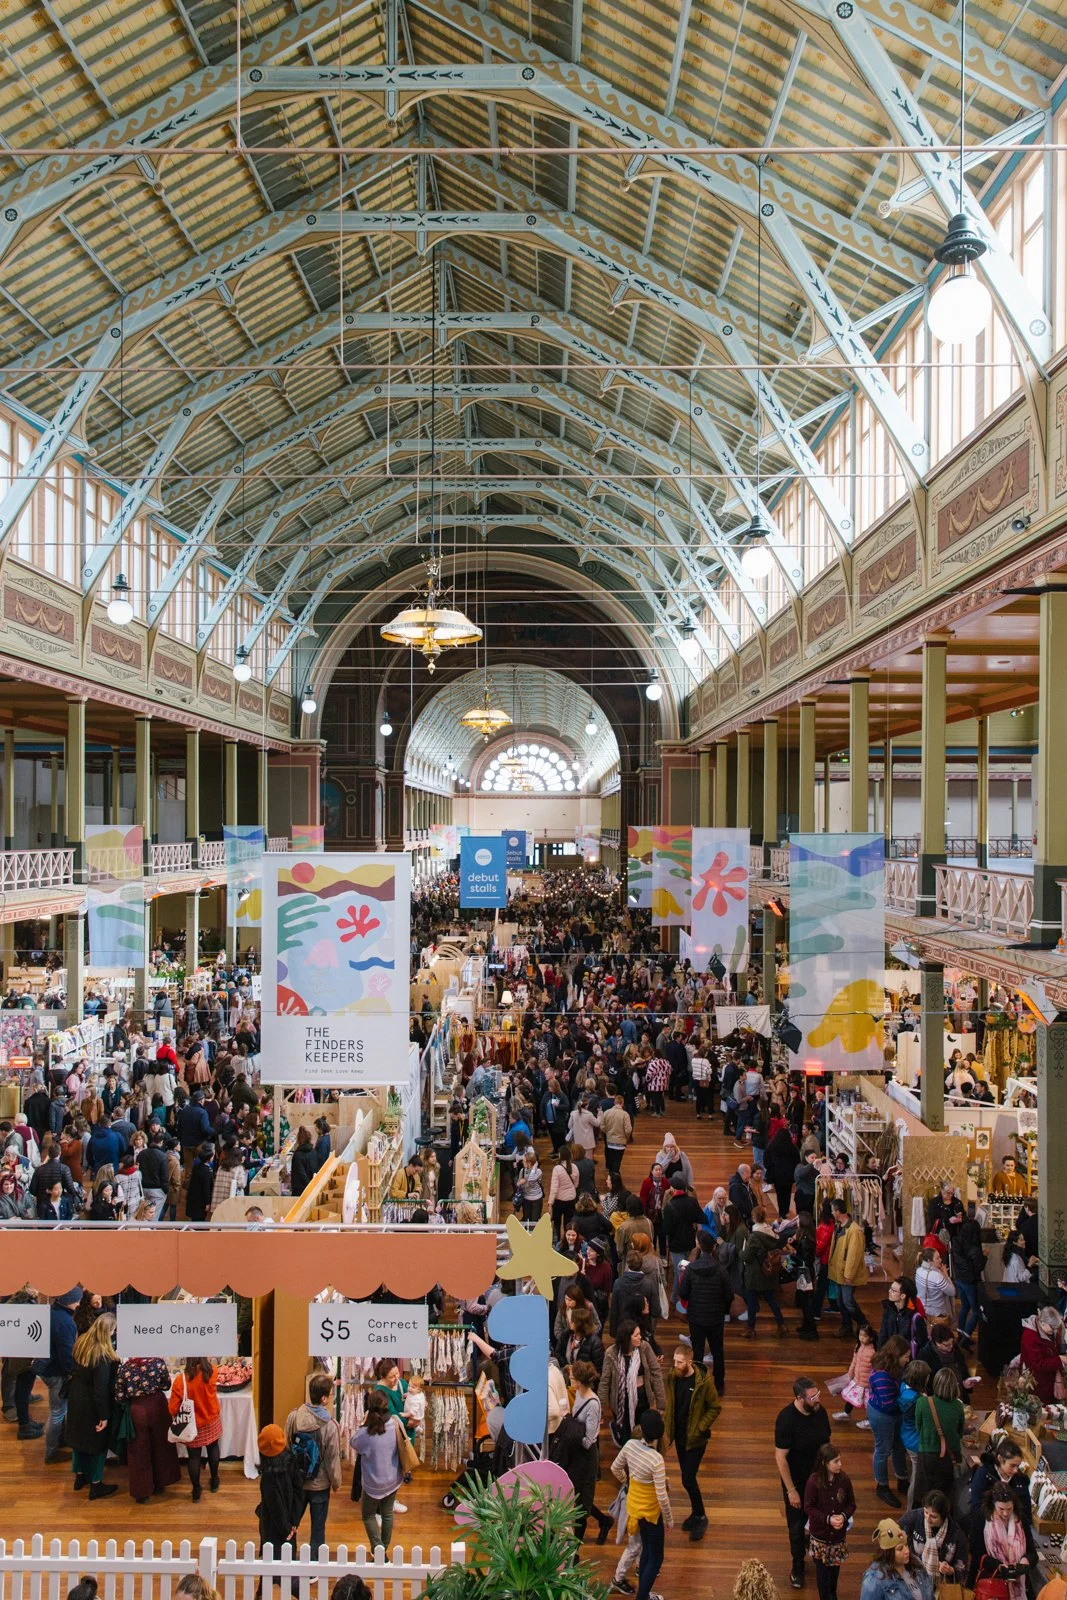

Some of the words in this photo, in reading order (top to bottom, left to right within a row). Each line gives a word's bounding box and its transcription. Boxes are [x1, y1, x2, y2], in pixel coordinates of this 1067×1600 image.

[467, 873, 500, 882] debut
[470, 884, 497, 893] stalls
[305, 1027, 330, 1038] THE
[305, 1039, 364, 1050] FINDERS
[305, 1052, 364, 1063] KEEPERS
[367, 1318, 418, 1329] Correct
[133, 1324, 163, 1335] Need
[169, 1324, 220, 1336] Change?
[320, 1317, 350, 1342] $5
[367, 1332, 397, 1343] Cash
